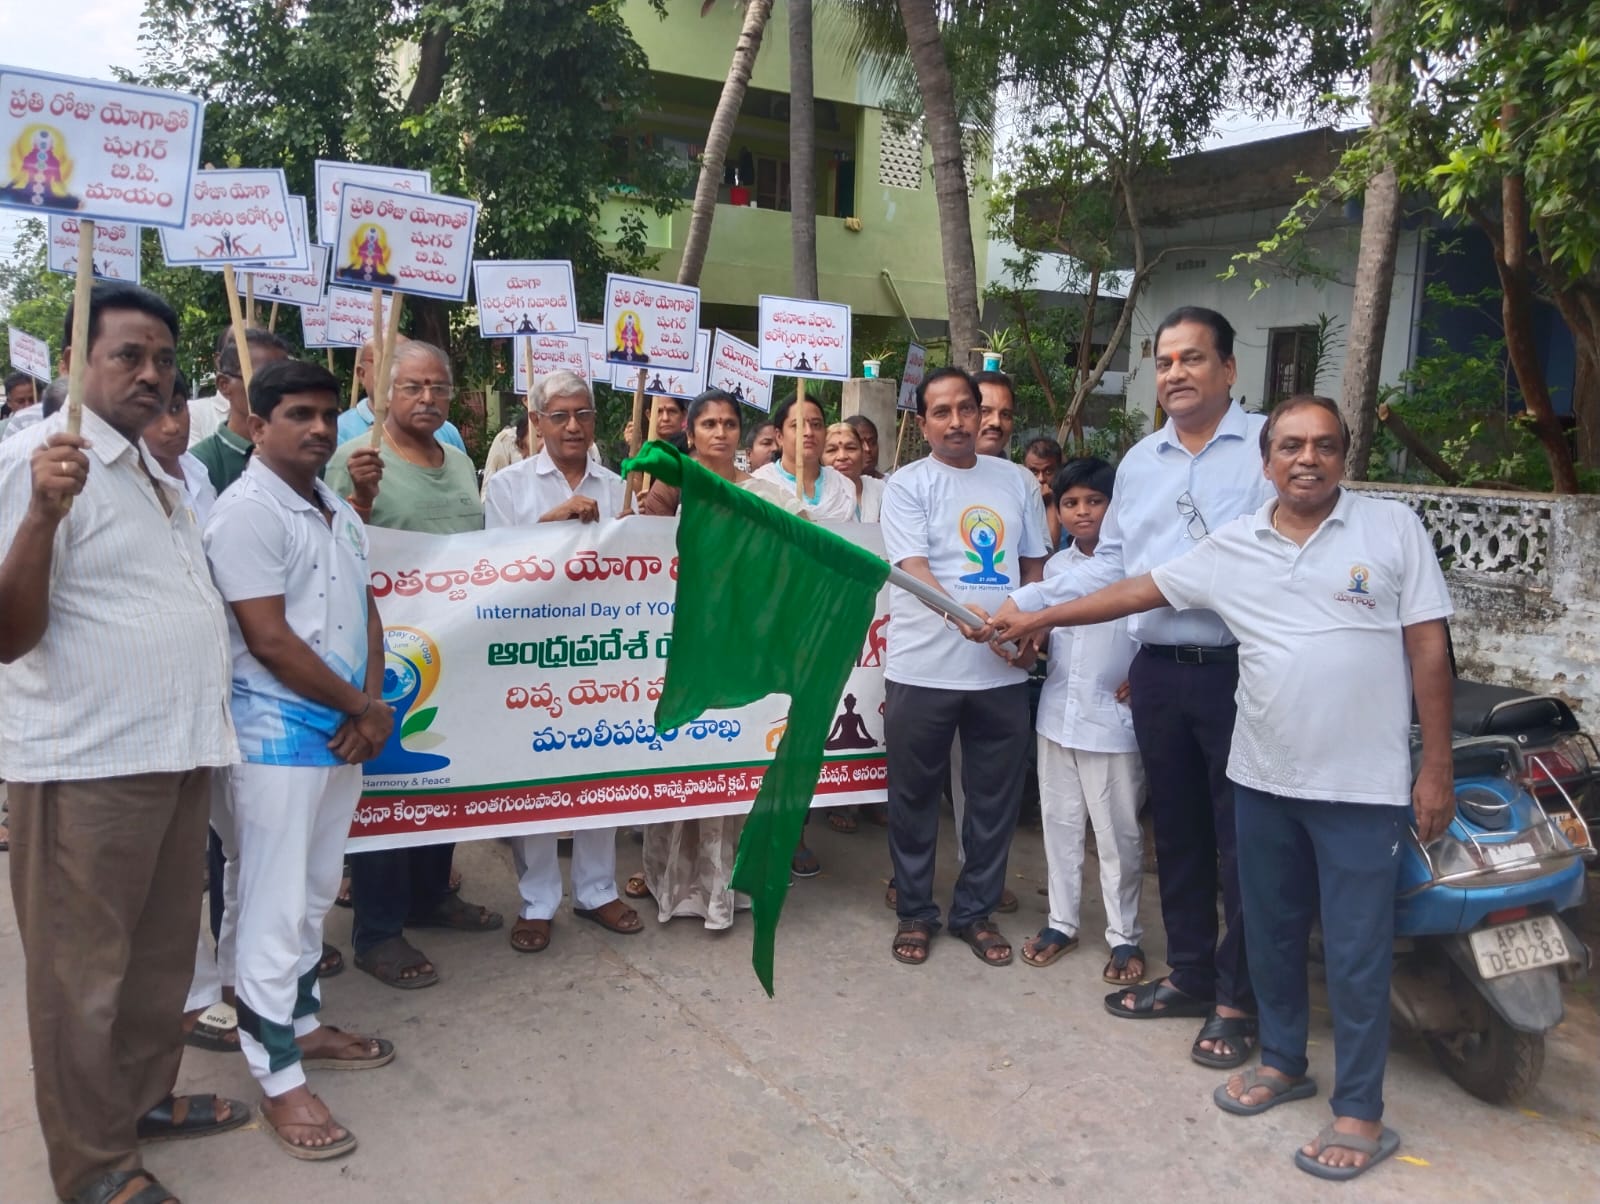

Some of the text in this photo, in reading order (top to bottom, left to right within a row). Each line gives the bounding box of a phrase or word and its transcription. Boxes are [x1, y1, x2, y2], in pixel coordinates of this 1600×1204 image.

[8, 89, 45, 118] ప్రతి
[99, 101, 190, 133] యోగాతో
[103, 136, 169, 160] షుగర్
[85, 183, 173, 208] మాయం
[229, 182, 270, 200] యోగా
[350, 197, 375, 219] ప్రతి
[409, 207, 469, 230] యోగాతో
[410, 231, 454, 249] షుగర్
[399, 265, 457, 285] మాయం
[506, 277, 542, 290] యోగా
[482, 294, 525, 313] సర్వరోగ
[614, 289, 631, 308] ప్రతి
[655, 295, 695, 313] యోగాతో
[656, 316, 687, 330] షుగర్
[650, 346, 690, 360] మాయం
[370, 555, 556, 601] ంతర్జాతీయ
[564, 550, 662, 582] యోగా
[476, 602, 587, 620] International
[591, 602, 621, 621] Day
[625, 601, 642, 617] of
[487, 628, 650, 668] ఆంధ్రప్రదేశ్
[505, 681, 564, 718] దివ్య
[567, 677, 640, 706] యోగ
[685, 716, 742, 743] శాఖ
[362, 777, 451, 788] Harmony & Peace
[352, 805, 391, 827] ాధనా
